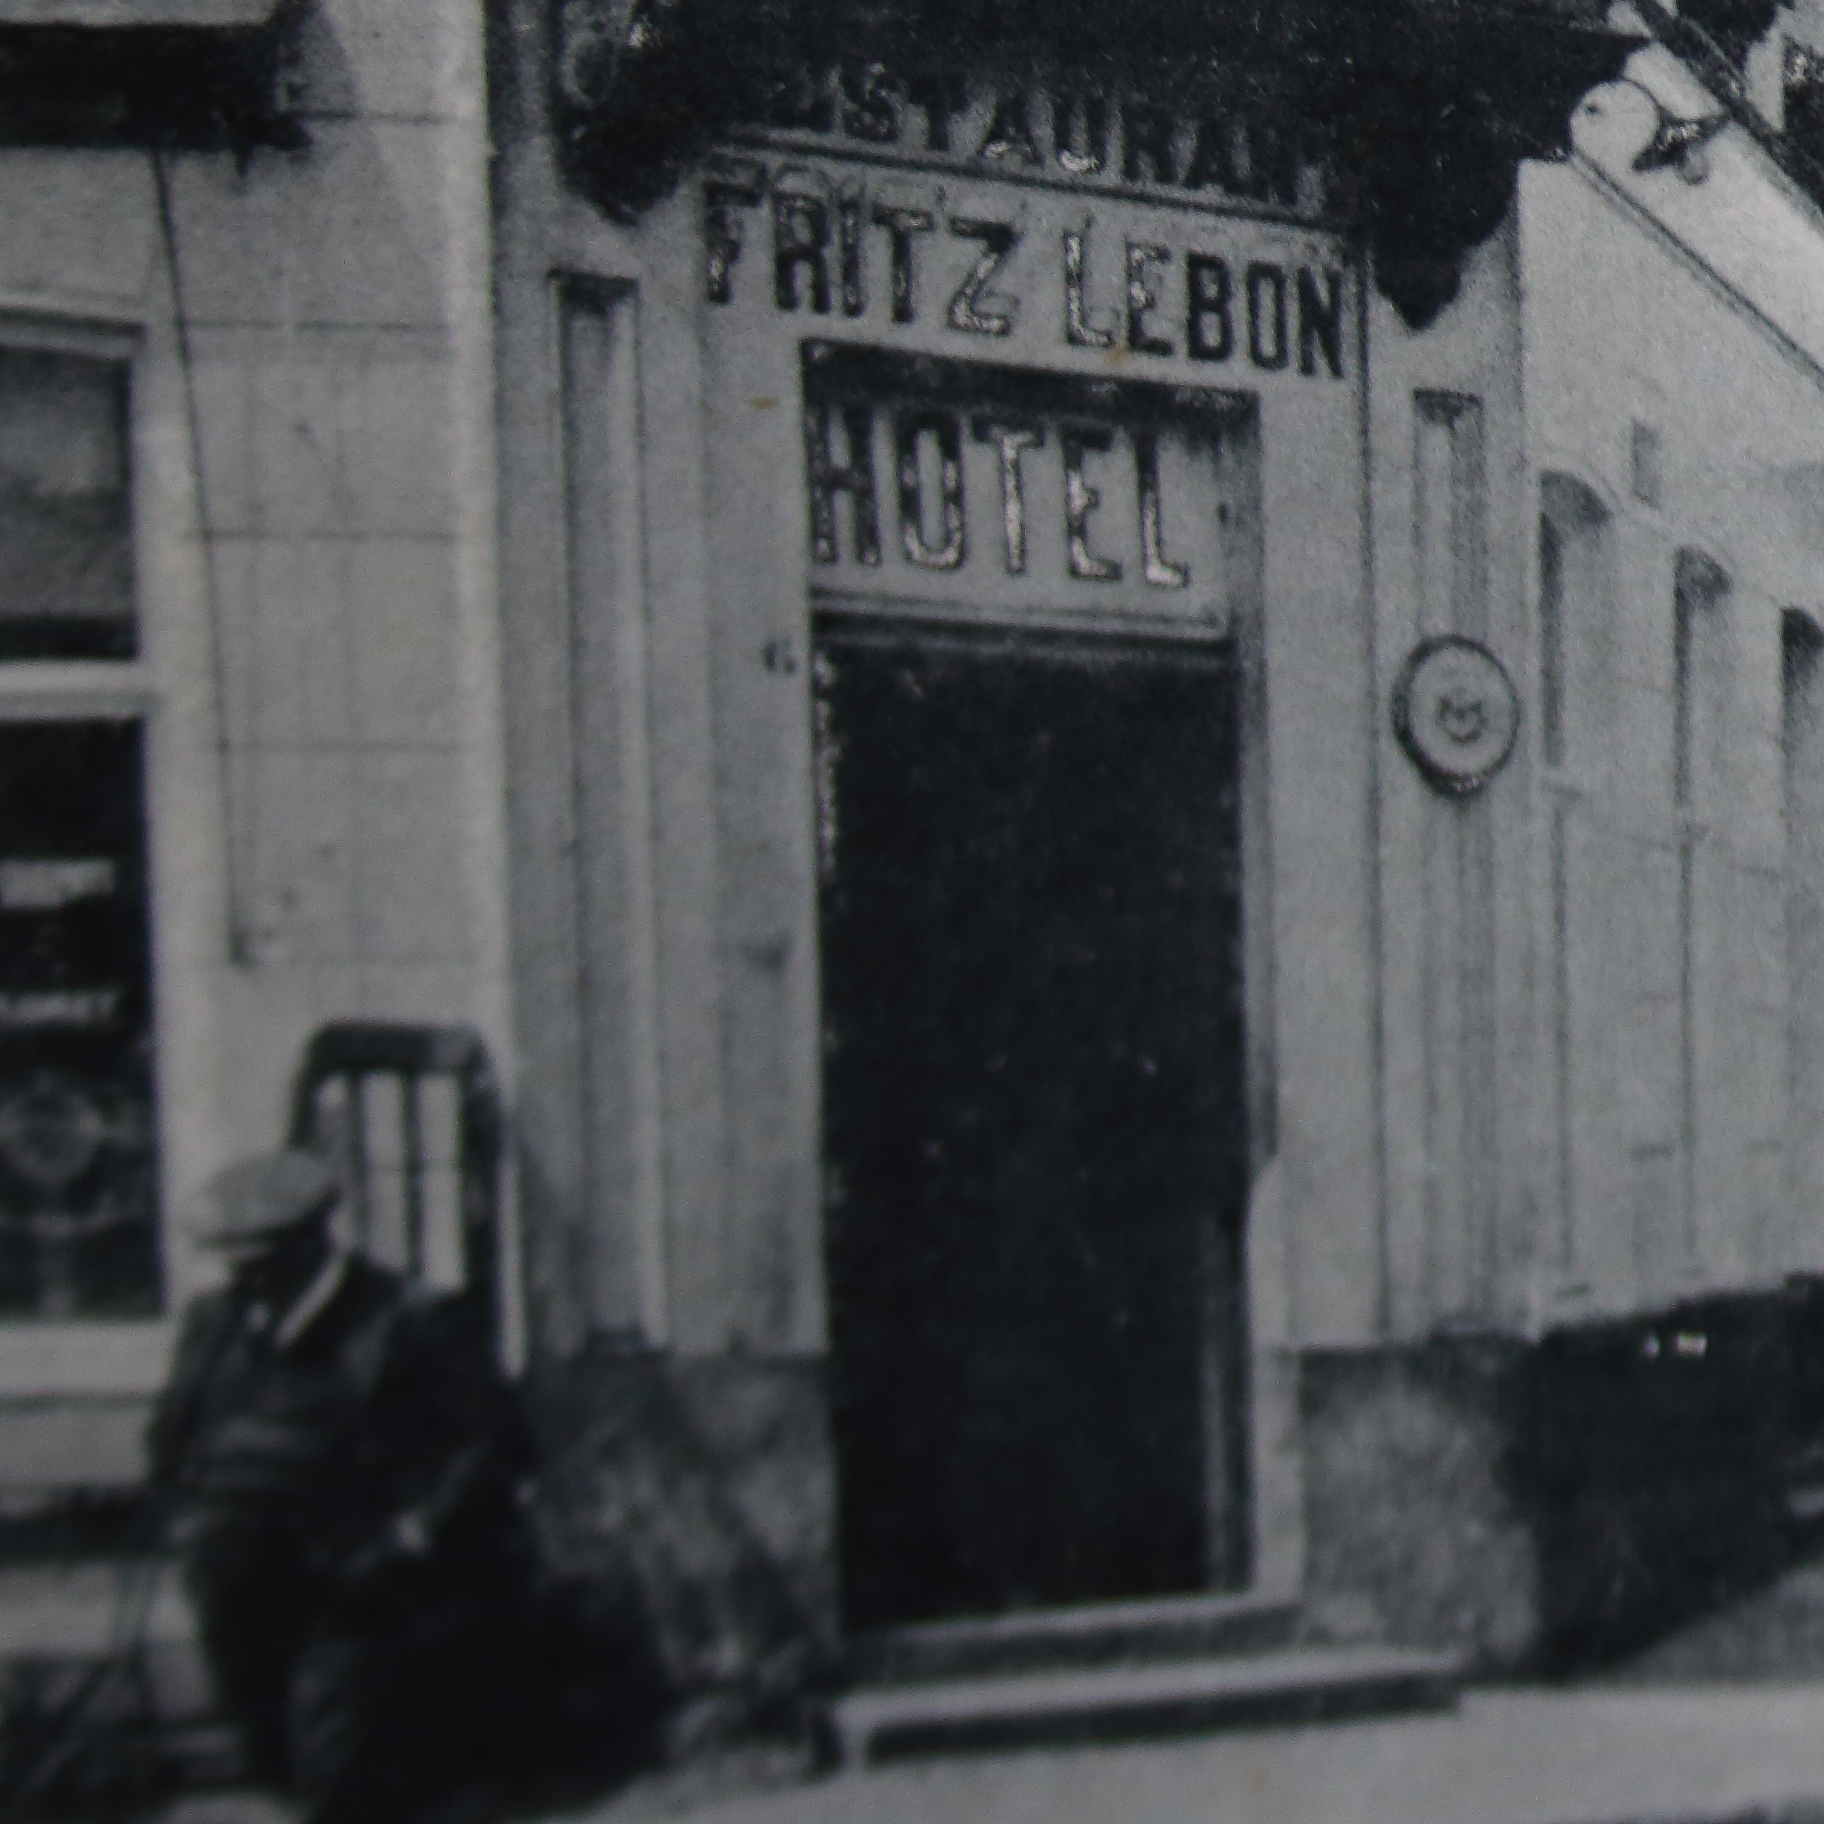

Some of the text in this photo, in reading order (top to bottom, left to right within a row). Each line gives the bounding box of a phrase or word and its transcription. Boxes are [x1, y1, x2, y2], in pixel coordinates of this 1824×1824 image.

[701, 176, 1346, 377] FRITZ LEBON
[807, 398, 1190, 588] HOTEL
